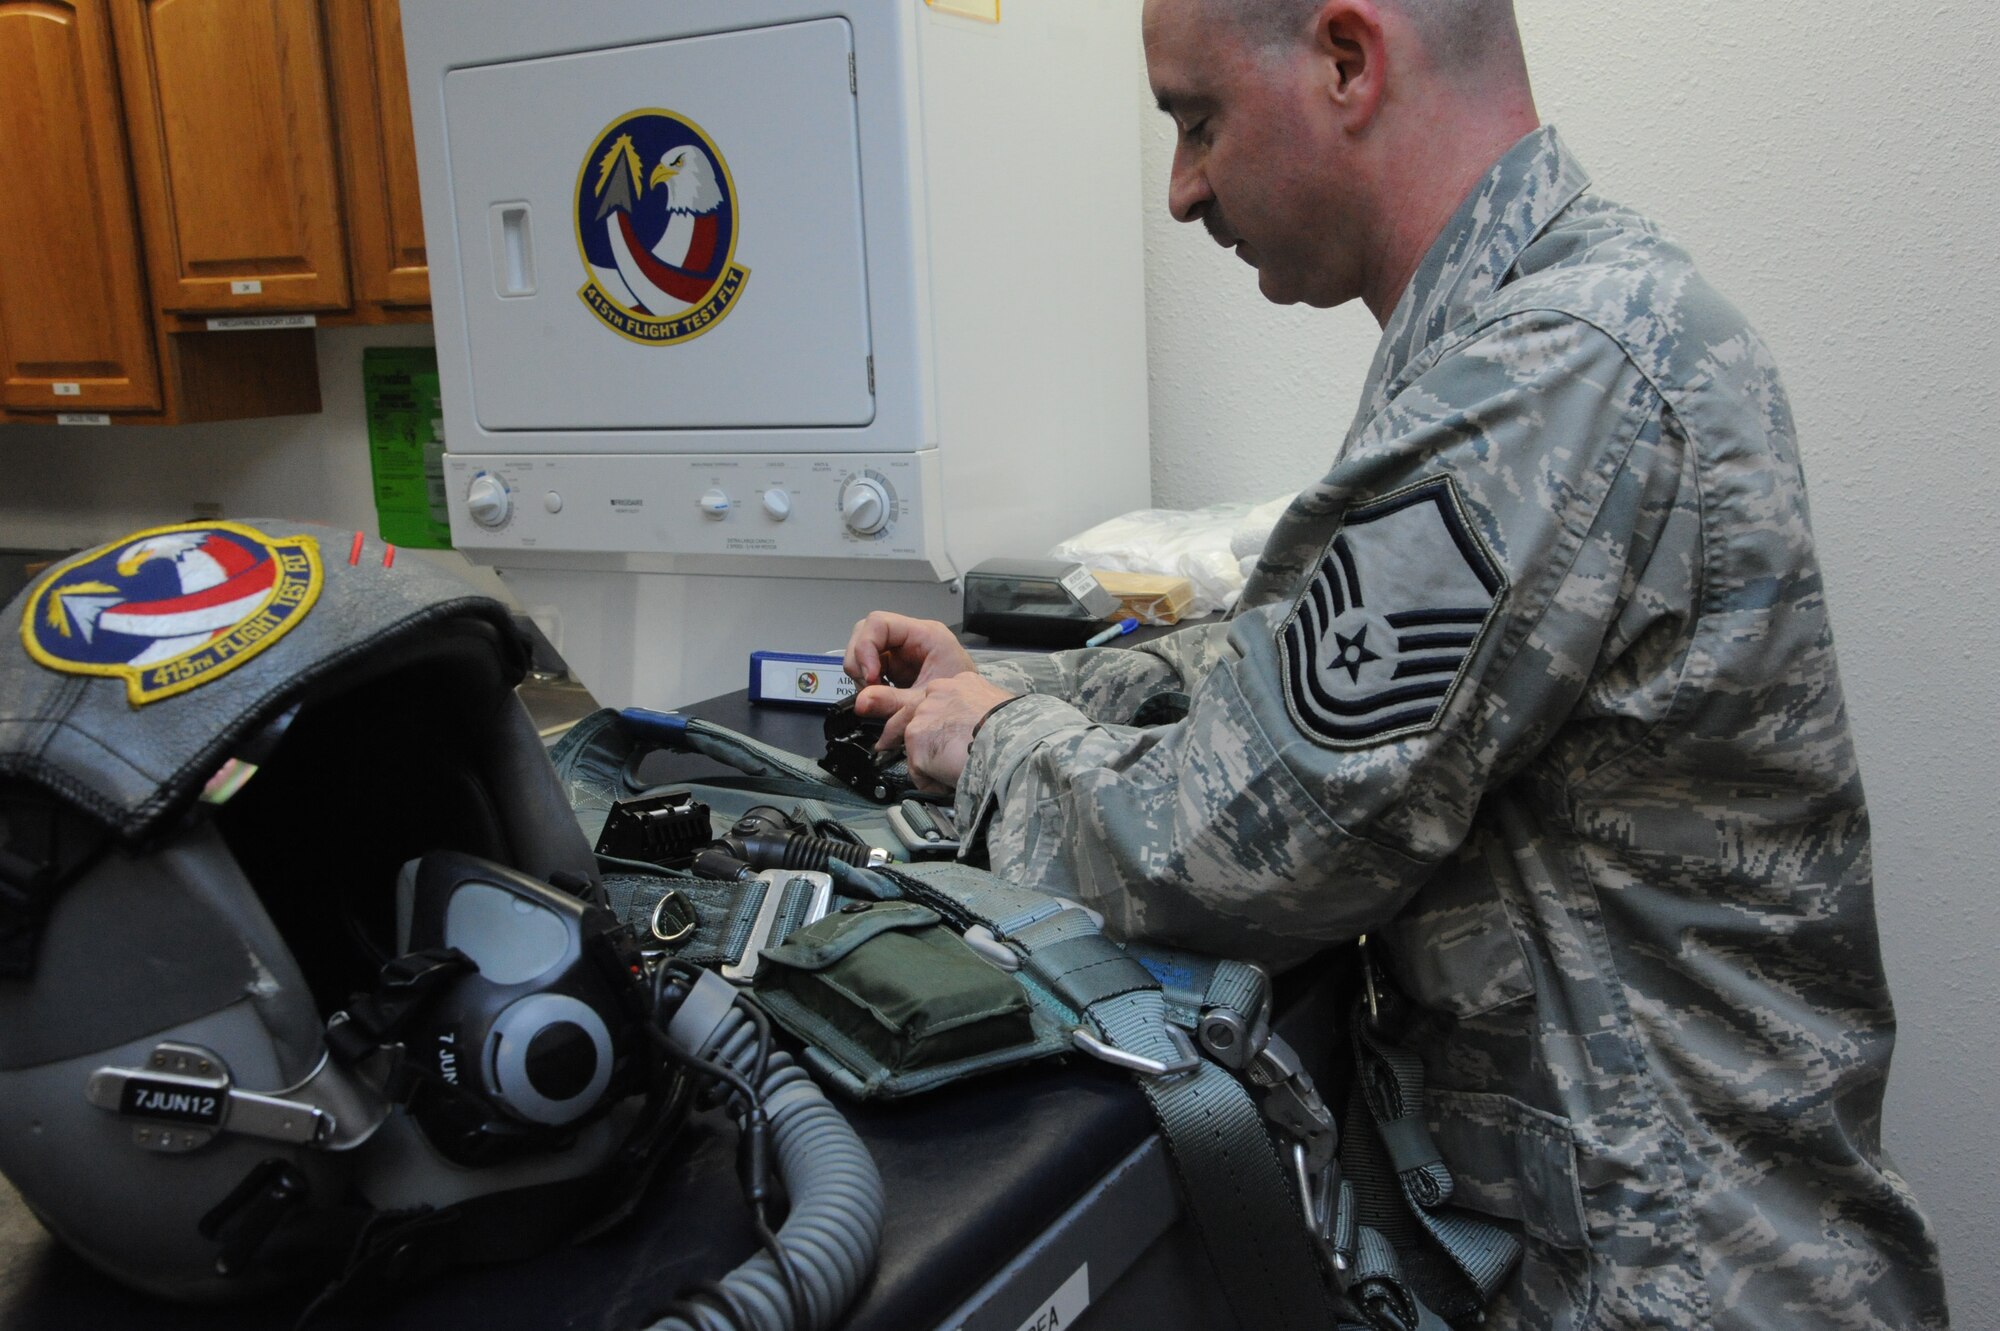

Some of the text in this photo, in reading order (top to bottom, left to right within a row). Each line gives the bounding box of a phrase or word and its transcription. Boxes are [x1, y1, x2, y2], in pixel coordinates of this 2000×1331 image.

[587, 271, 740, 338] 415TH FLIGHT TEST FLT
[153, 553, 310, 686] 415TH FLIGHT TEST FLT
[438, 1032, 455, 1044] 7
[135, 1088, 216, 1116] 7JUN12
